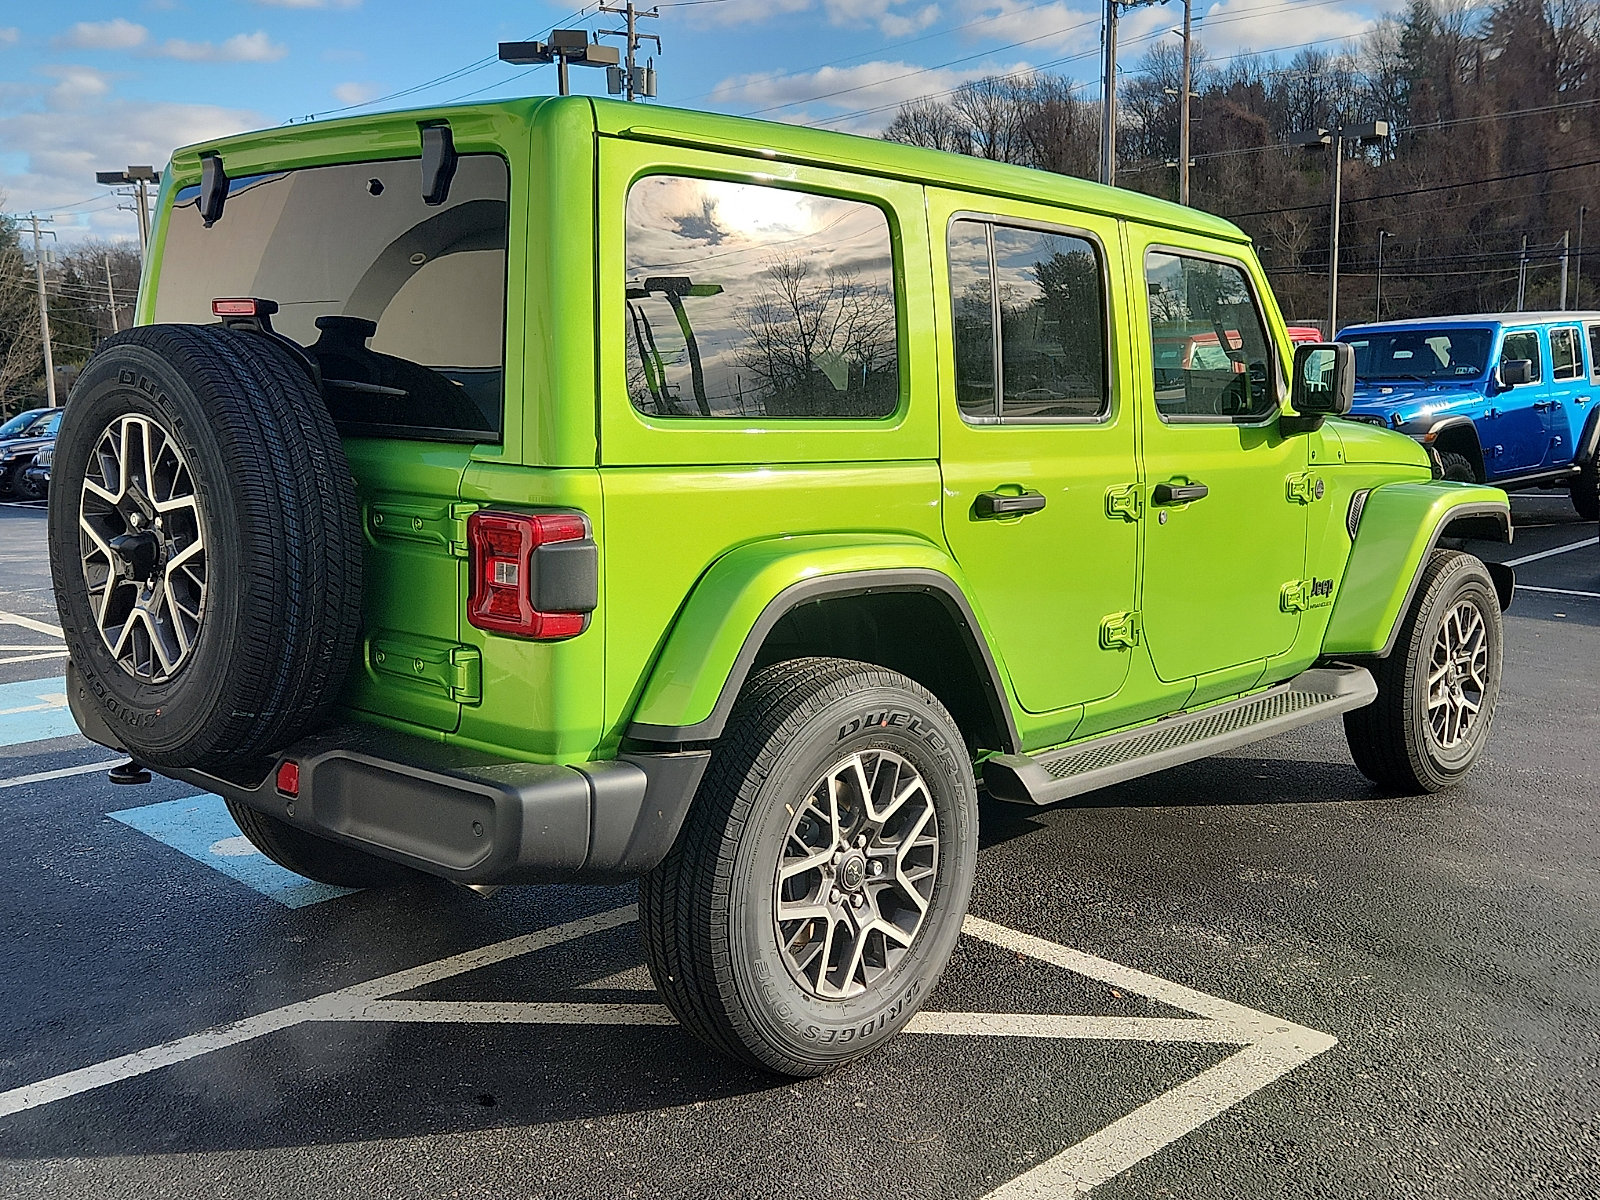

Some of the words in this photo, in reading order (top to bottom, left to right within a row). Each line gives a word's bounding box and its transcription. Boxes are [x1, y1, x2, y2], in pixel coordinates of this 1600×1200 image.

[118, 368, 215, 519] DUELER
[1310, 577, 1333, 598] Jeep
[834, 708, 959, 777] DUELER
[753, 958, 922, 1046] BRIDGESTONE
